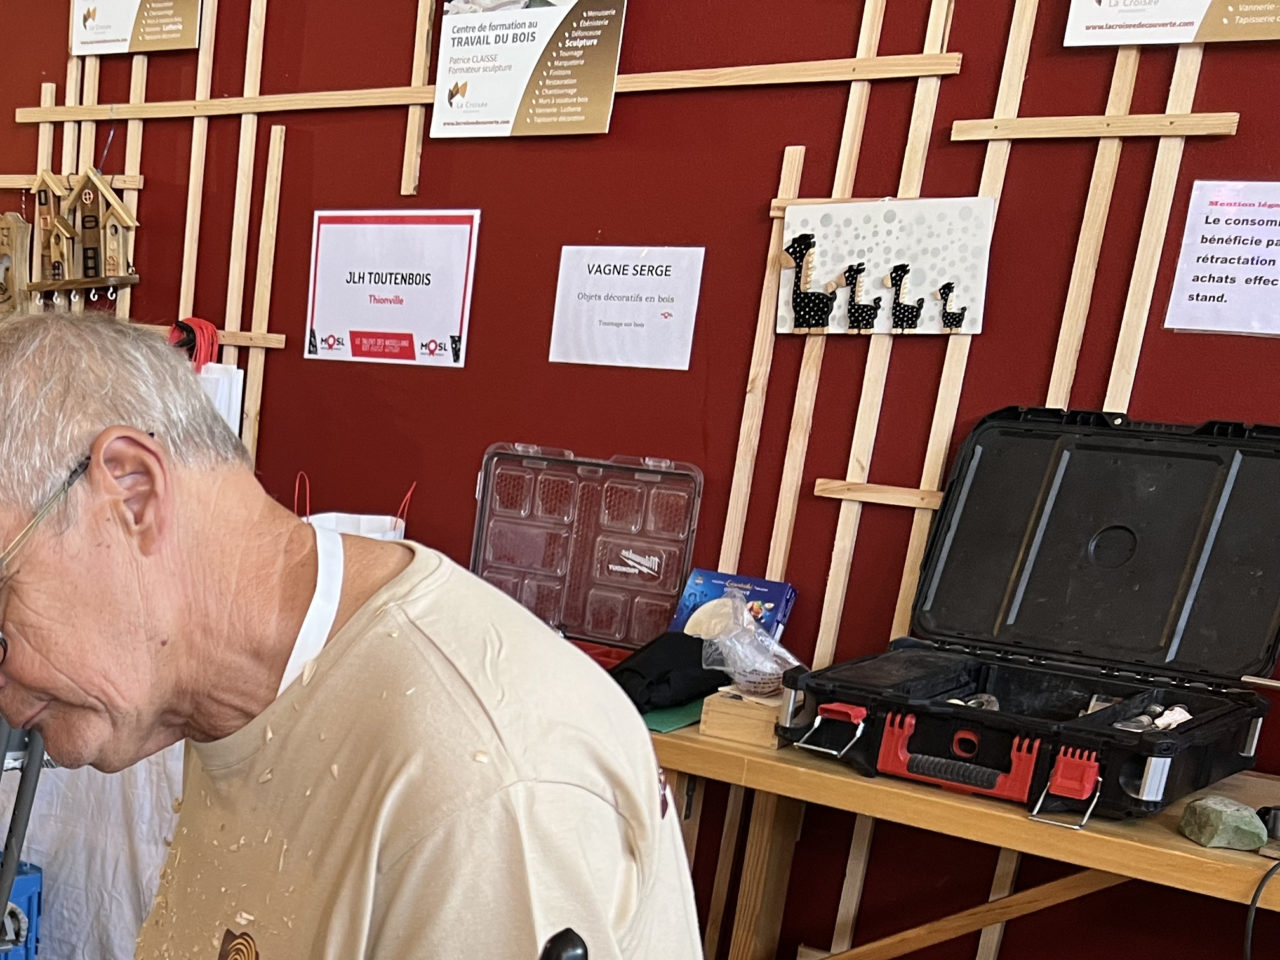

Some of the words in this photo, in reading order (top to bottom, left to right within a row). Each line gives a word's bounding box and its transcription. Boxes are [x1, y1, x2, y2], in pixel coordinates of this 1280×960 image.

[452, 24, 476, 34] Centre
[477, 24, 487, 33] de
[488, 21, 526, 32] formation
[528, 20, 538, 29] au
[451, 35, 491, 47] TRAVAIL
[494, 33, 509, 44] DU
[512, 31, 536, 43] BOIS
[565, 38, 598, 48] Sculpture
[449, 55, 471, 64] Patrice
[448, 65, 481, 74] Formateur
[482, 64, 513, 73] sculpture
[1208, 200, 1256, 208] Mention
[1204, 215, 1220, 225] Le
[1224, 216, 1280, 227] consom
[1200, 234, 1262, 247] bénéficie
[1196, 254, 1276, 267] rétractation
[587, 263, 629, 276] VAGNE
[632, 264, 672, 277] SERGE
[345, 271, 365, 285] JLH
[368, 271, 431, 287] TOUTENBOIS
[1192, 273, 1236, 284] achats
[368, 294, 404, 306] Thionville
[577, 291, 602, 303] Objets
[604, 292, 643, 303] décoratifs
[658, 294, 675, 304] bois
[1188, 292, 1228, 303] stand.
[320, 334, 345, 350] MOSL
[420, 339, 448, 357] MOSL
